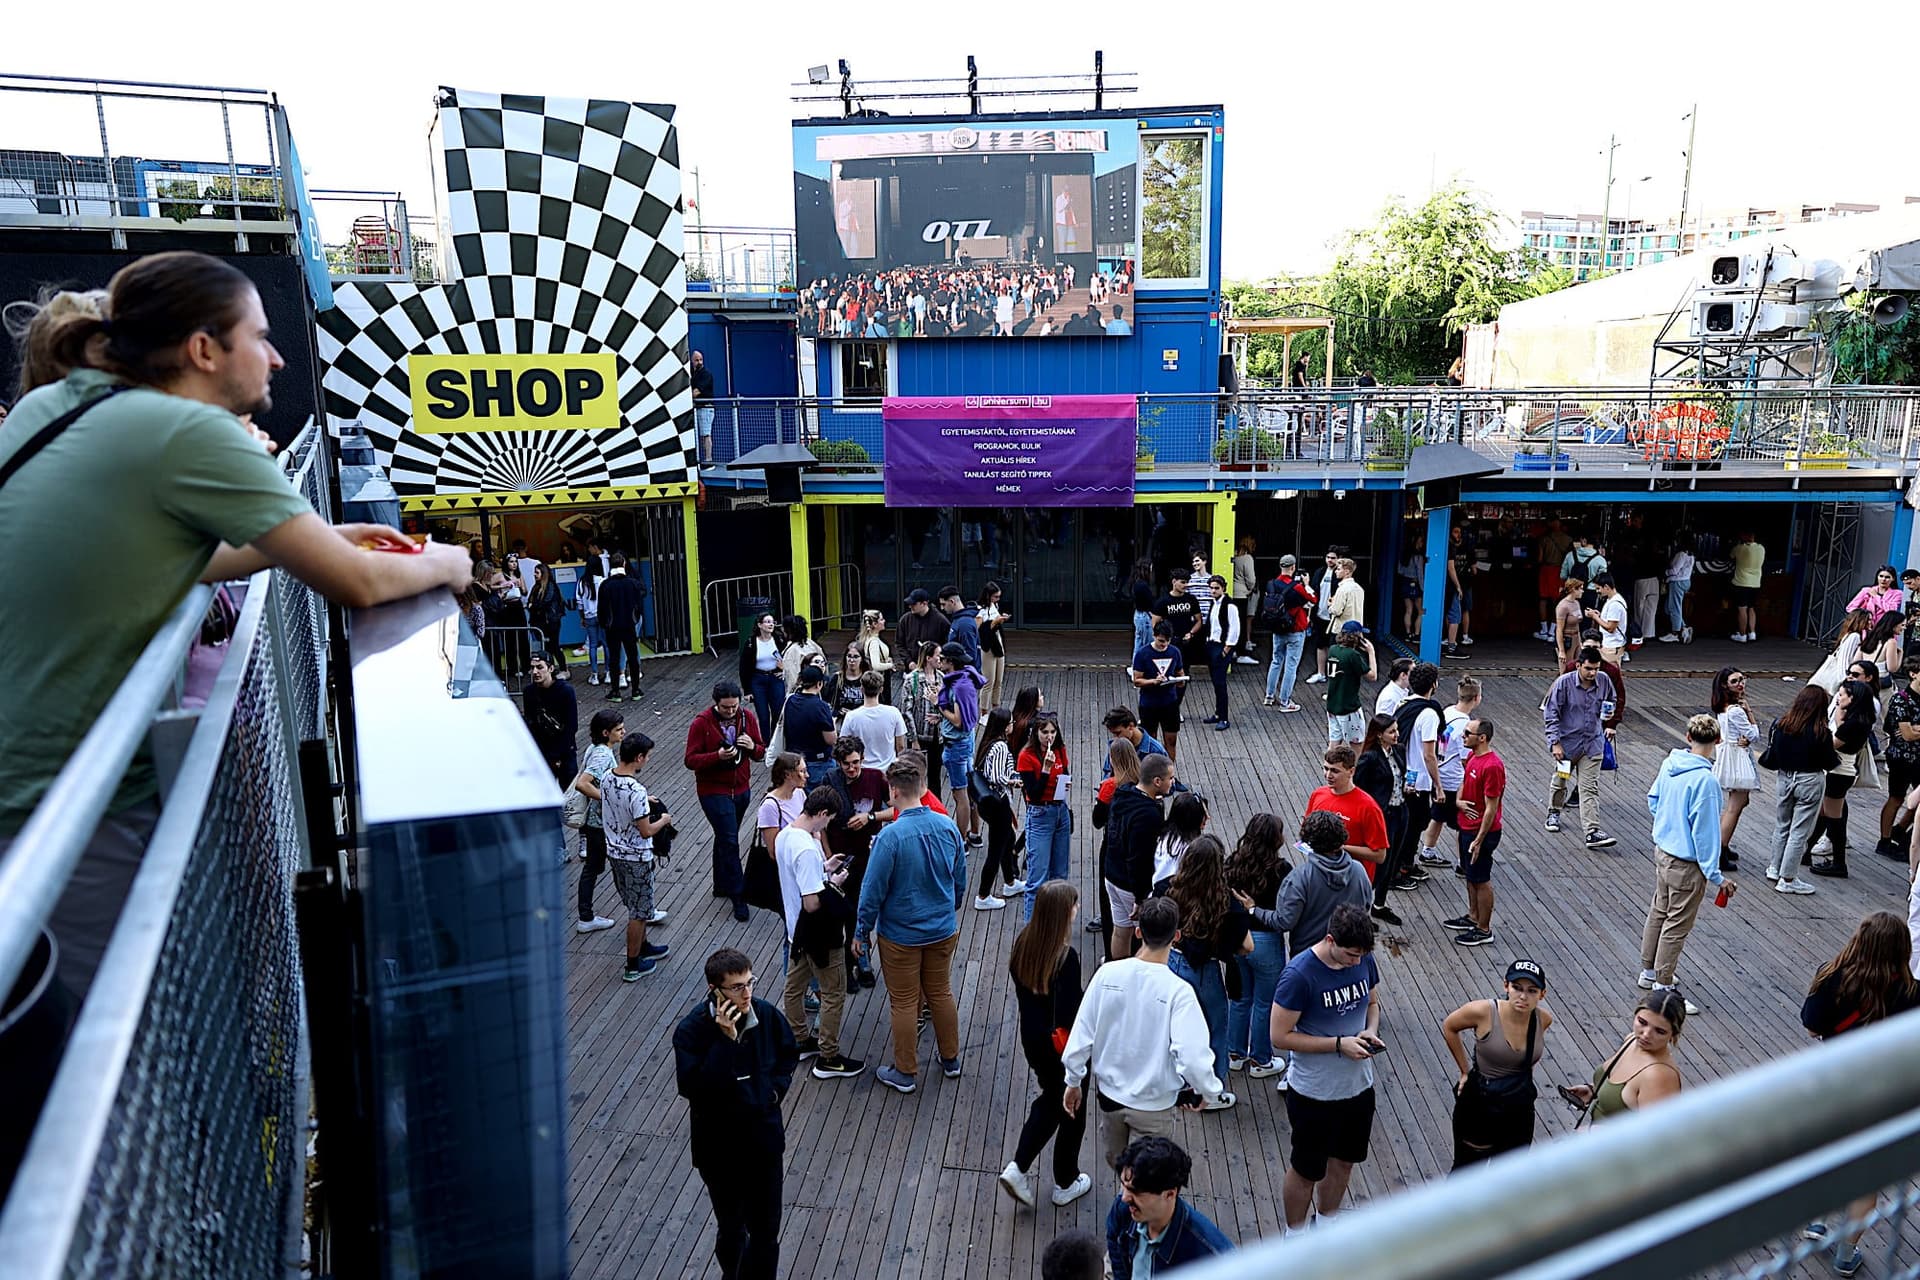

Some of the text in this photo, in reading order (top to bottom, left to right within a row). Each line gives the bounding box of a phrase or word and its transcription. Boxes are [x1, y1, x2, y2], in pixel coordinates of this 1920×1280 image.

[426, 368, 605, 419] SHOP
[941, 426, 1076, 436] EGYETEMISTÁKTÓL, EGYETEMISTÁKNAK
[973, 443, 1020, 451] PROGRAMOK,
[1643, 443, 1712, 461] FIRE
[981, 455, 1037, 464] AKTUÁLIS HÍREK
[964, 470, 999, 478] TANULÁST
[996, 484, 1021, 492] MÉMEK
[1167, 602, 1191, 612] HUGO
[1515, 961, 1540, 975] QUEEN
[1323, 979, 1369, 1008] HAWAII
